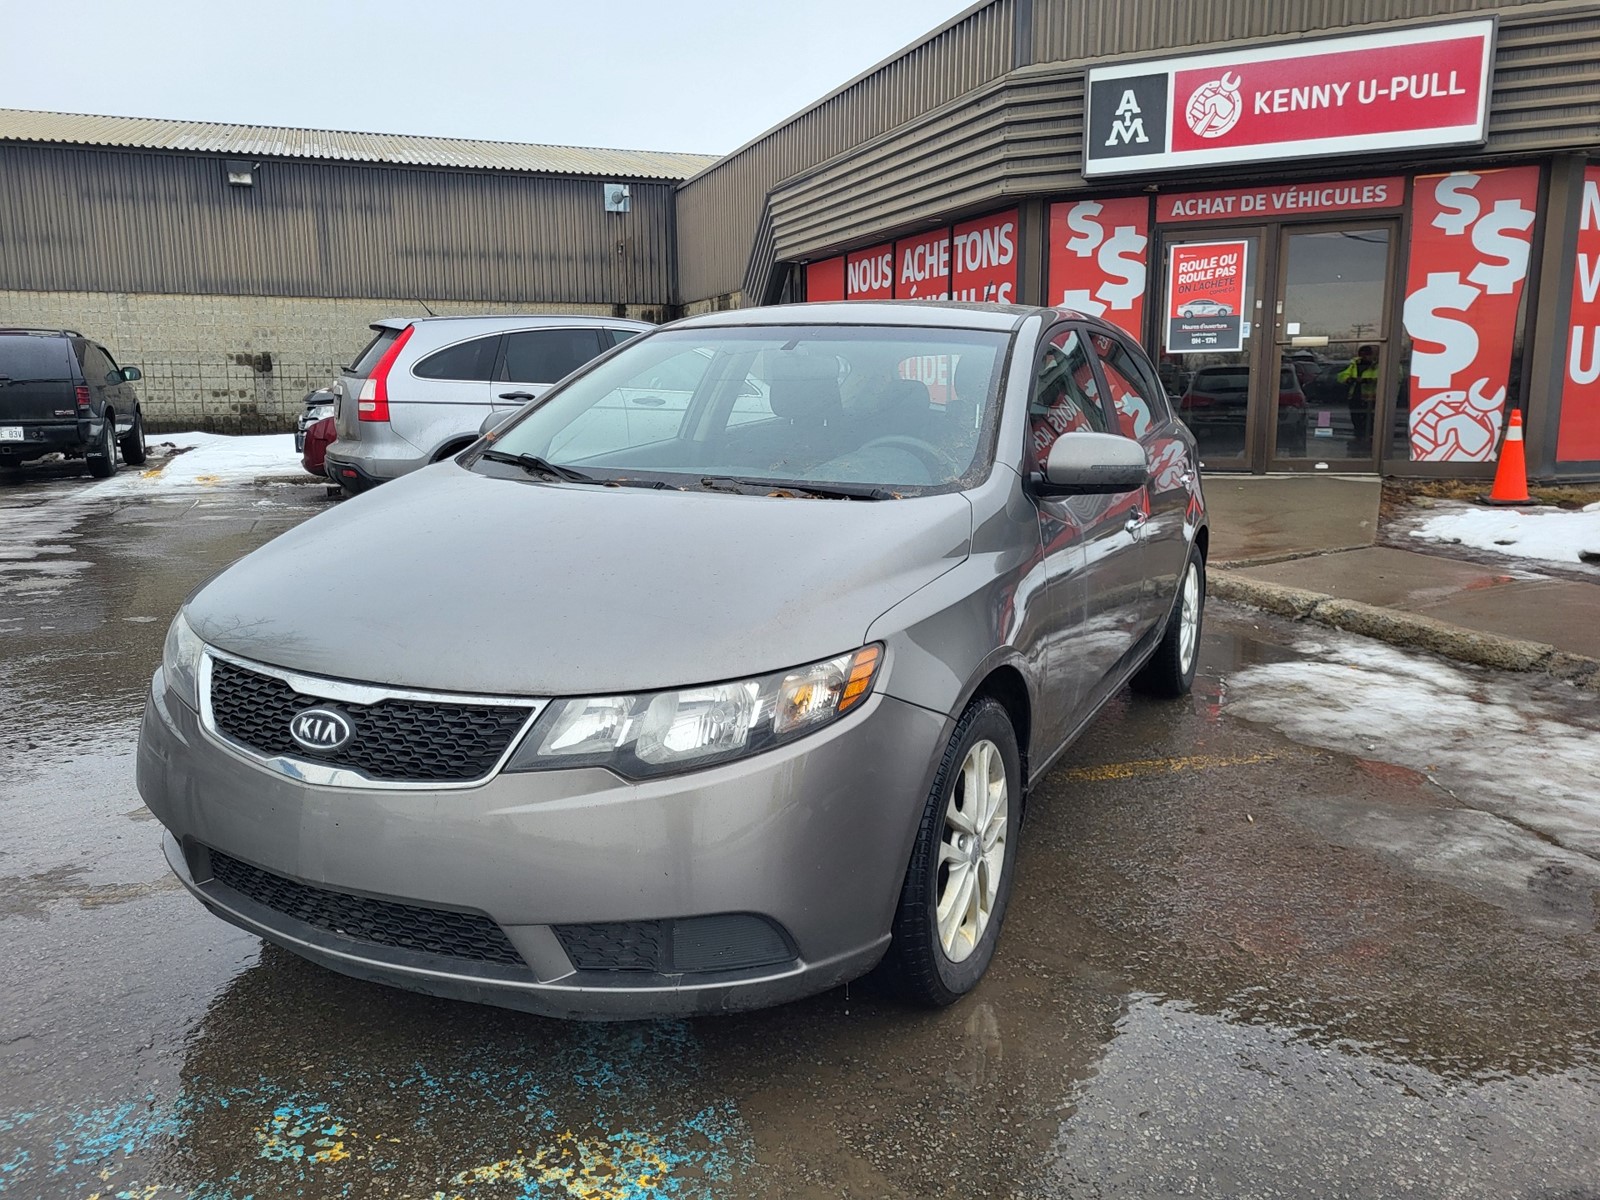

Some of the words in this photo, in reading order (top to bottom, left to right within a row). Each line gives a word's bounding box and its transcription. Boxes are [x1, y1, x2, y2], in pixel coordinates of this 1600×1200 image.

[1254, 82, 1351, 115] KENNY
[1358, 70, 1466, 104] U-PULL
[1171, 196, 1236, 216] ACHAT
[1240, 193, 1267, 212] DE
[1272, 184, 1387, 209] VÉHICULES
[848, 253, 893, 295] NOUS
[901, 223, 1014, 284] ACHETONS
[1178, 256, 1219, 274] ROULE
[1219, 253, 1238, 266] OU
[1178, 269, 1214, 284] ROULE
[1215, 265, 1237, 278] PAS
[1178, 284, 1192, 294] ON
[298, 716, 337, 743] KIA
